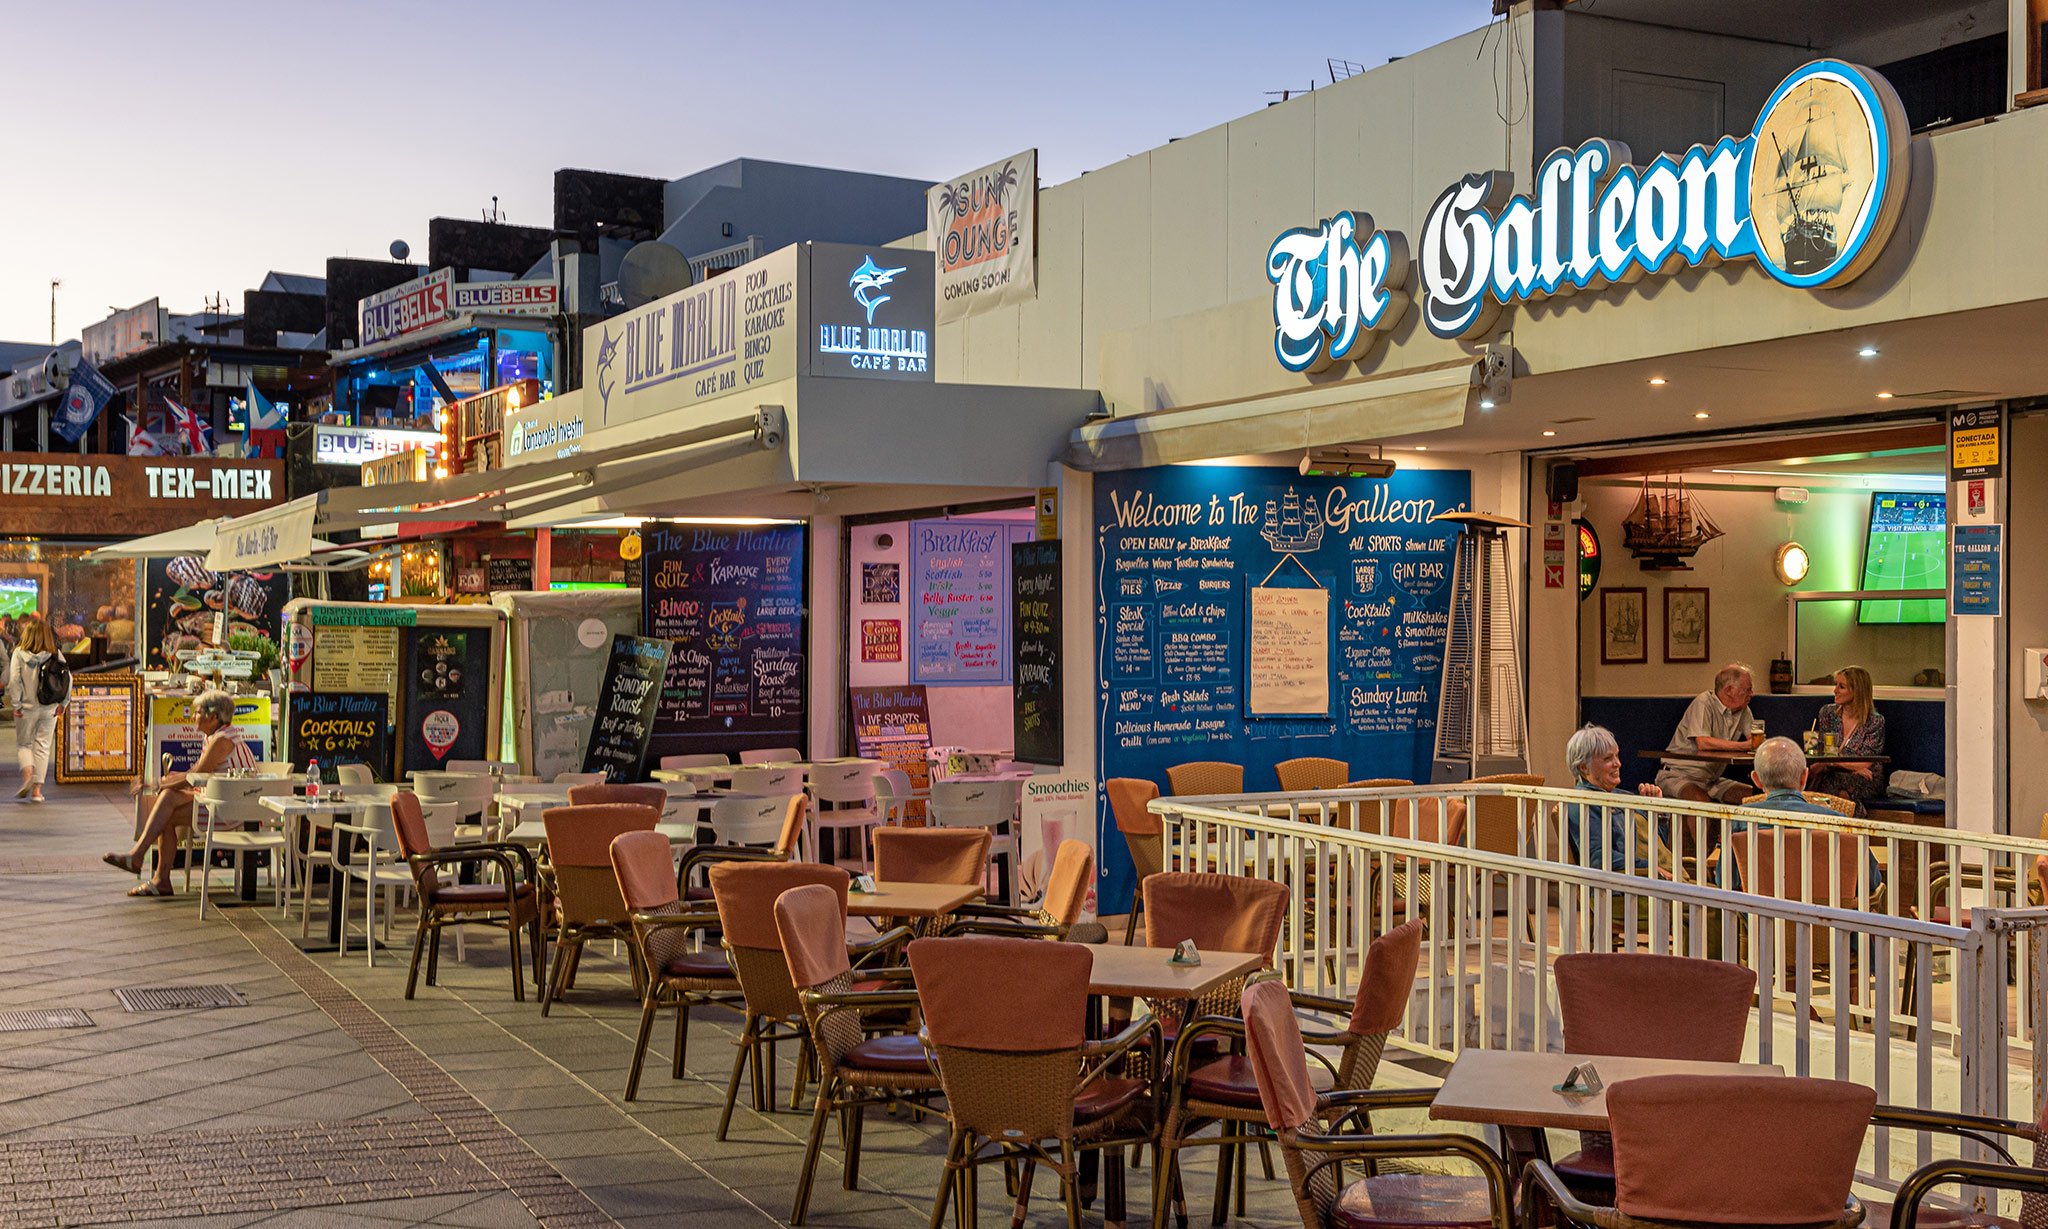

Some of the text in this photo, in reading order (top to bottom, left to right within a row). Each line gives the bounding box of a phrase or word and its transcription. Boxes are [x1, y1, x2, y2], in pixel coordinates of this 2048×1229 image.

[957, 170, 1003, 218] SUN
[1270, 147, 1753, 368] The Galleon
[745, 268, 768, 294] FOOD
[944, 268, 1011, 301] COMING SOON!
[459, 286, 553, 306] BLUEBELLS
[744, 282, 793, 315] COCKTAILS
[365, 284, 444, 343] BLUEBELLS
[744, 307, 786, 337] KARAOKE
[625, 279, 737, 385] BLUE MARLIN
[820, 324, 928, 356] BLUE MARLIN
[744, 335, 772, 360] BINGO
[743, 359, 764, 384] QUIZ
[850, 353, 928, 372] CAFÉ BAR
[695, 371, 736, 398] CAFÉ BAR
[1956, 433, 1996, 443] CONECTADA
[0, 463, 272, 500] IZZERIA TEX-MEX
[1110, 483, 1436, 534] Welcome to The Galleon
[652, 529, 792, 552] The Blue Marlin
[920, 528, 997, 556] Breakfast
[1120, 535, 1233, 553] OPEN EARLY for Breakfast
[1348, 534, 1447, 553] All SPORTS shown LIVE
[1954, 544, 1992, 553] THE GALLEON
[663, 560, 682, 573] FUN
[766, 556, 792, 568] EVERY
[766, 566, 790, 575] NIGHT
[930, 557, 964, 570] English
[1115, 557, 1149, 573] Baguettes
[1200, 556, 1235, 570] Sandwiches
[1354, 565, 1376, 575] LARGE
[654, 572, 690, 590] QUIZ
[710, 564, 760, 585] KARAOKE
[925, 569, 963, 581] Scottish
[1355, 574, 1375, 584] BEER
[1392, 562, 1445, 584] GIN BAR
[865, 576, 899, 590] DRINK
[1121, 584, 1143, 596] PIES
[1155, 578, 1183, 593] Pizzas
[1199, 579, 1231, 590] BURGERS
[864, 590, 899, 603] HAPPY
[708, 608, 746, 629] Cocktails
[756, 607, 778, 617] LARGE
[928, 605, 960, 619] Veggie
[1019, 600, 1049, 621] FUN QUIZ
[1120, 605, 1144, 621] Steak
[1180, 602, 1226, 620] Cod & chips
[1347, 602, 1392, 619] Cocktails
[1402, 610, 1448, 625] Milkshakes
[312, 615, 373, 626] CIGARETTES
[1116, 618, 1145, 635] Special
[865, 633, 898, 645] BEER
[874, 626, 899, 635] GOOD
[1172, 632, 1217, 644] BBQ COMBO
[1394, 624, 1448, 638] & Smoothies
[874, 644, 899, 653] GOOD
[1344, 645, 1392, 661] Liqueur Coffee
[753, 656, 798, 678] Sunday
[1367, 657, 1393, 668] Chocolate
[760, 671, 787, 687] Roast
[1019, 663, 1051, 685] KARAOKE
[612, 674, 654, 698] SUNDAY
[293, 695, 378, 713] The Blue Marlin
[610, 691, 643, 716] Roast
[854, 691, 923, 710] The Blue Marlin
[1120, 688, 1139, 703] KIDS
[1160, 689, 1181, 708] fresh
[1183, 688, 1210, 703] Salads
[1349, 683, 1429, 709] Sunday Lunch
[1119, 701, 1142, 712] MENU
[300, 718, 376, 738] COCKTAILS
[862, 712, 920, 726] LIVE SPORTS
[1115, 718, 1226, 736] Delicious Homemade Lasagne
[1283, 720, 1330, 737] Specials
[1028, 779, 1090, 796] Smoothies
